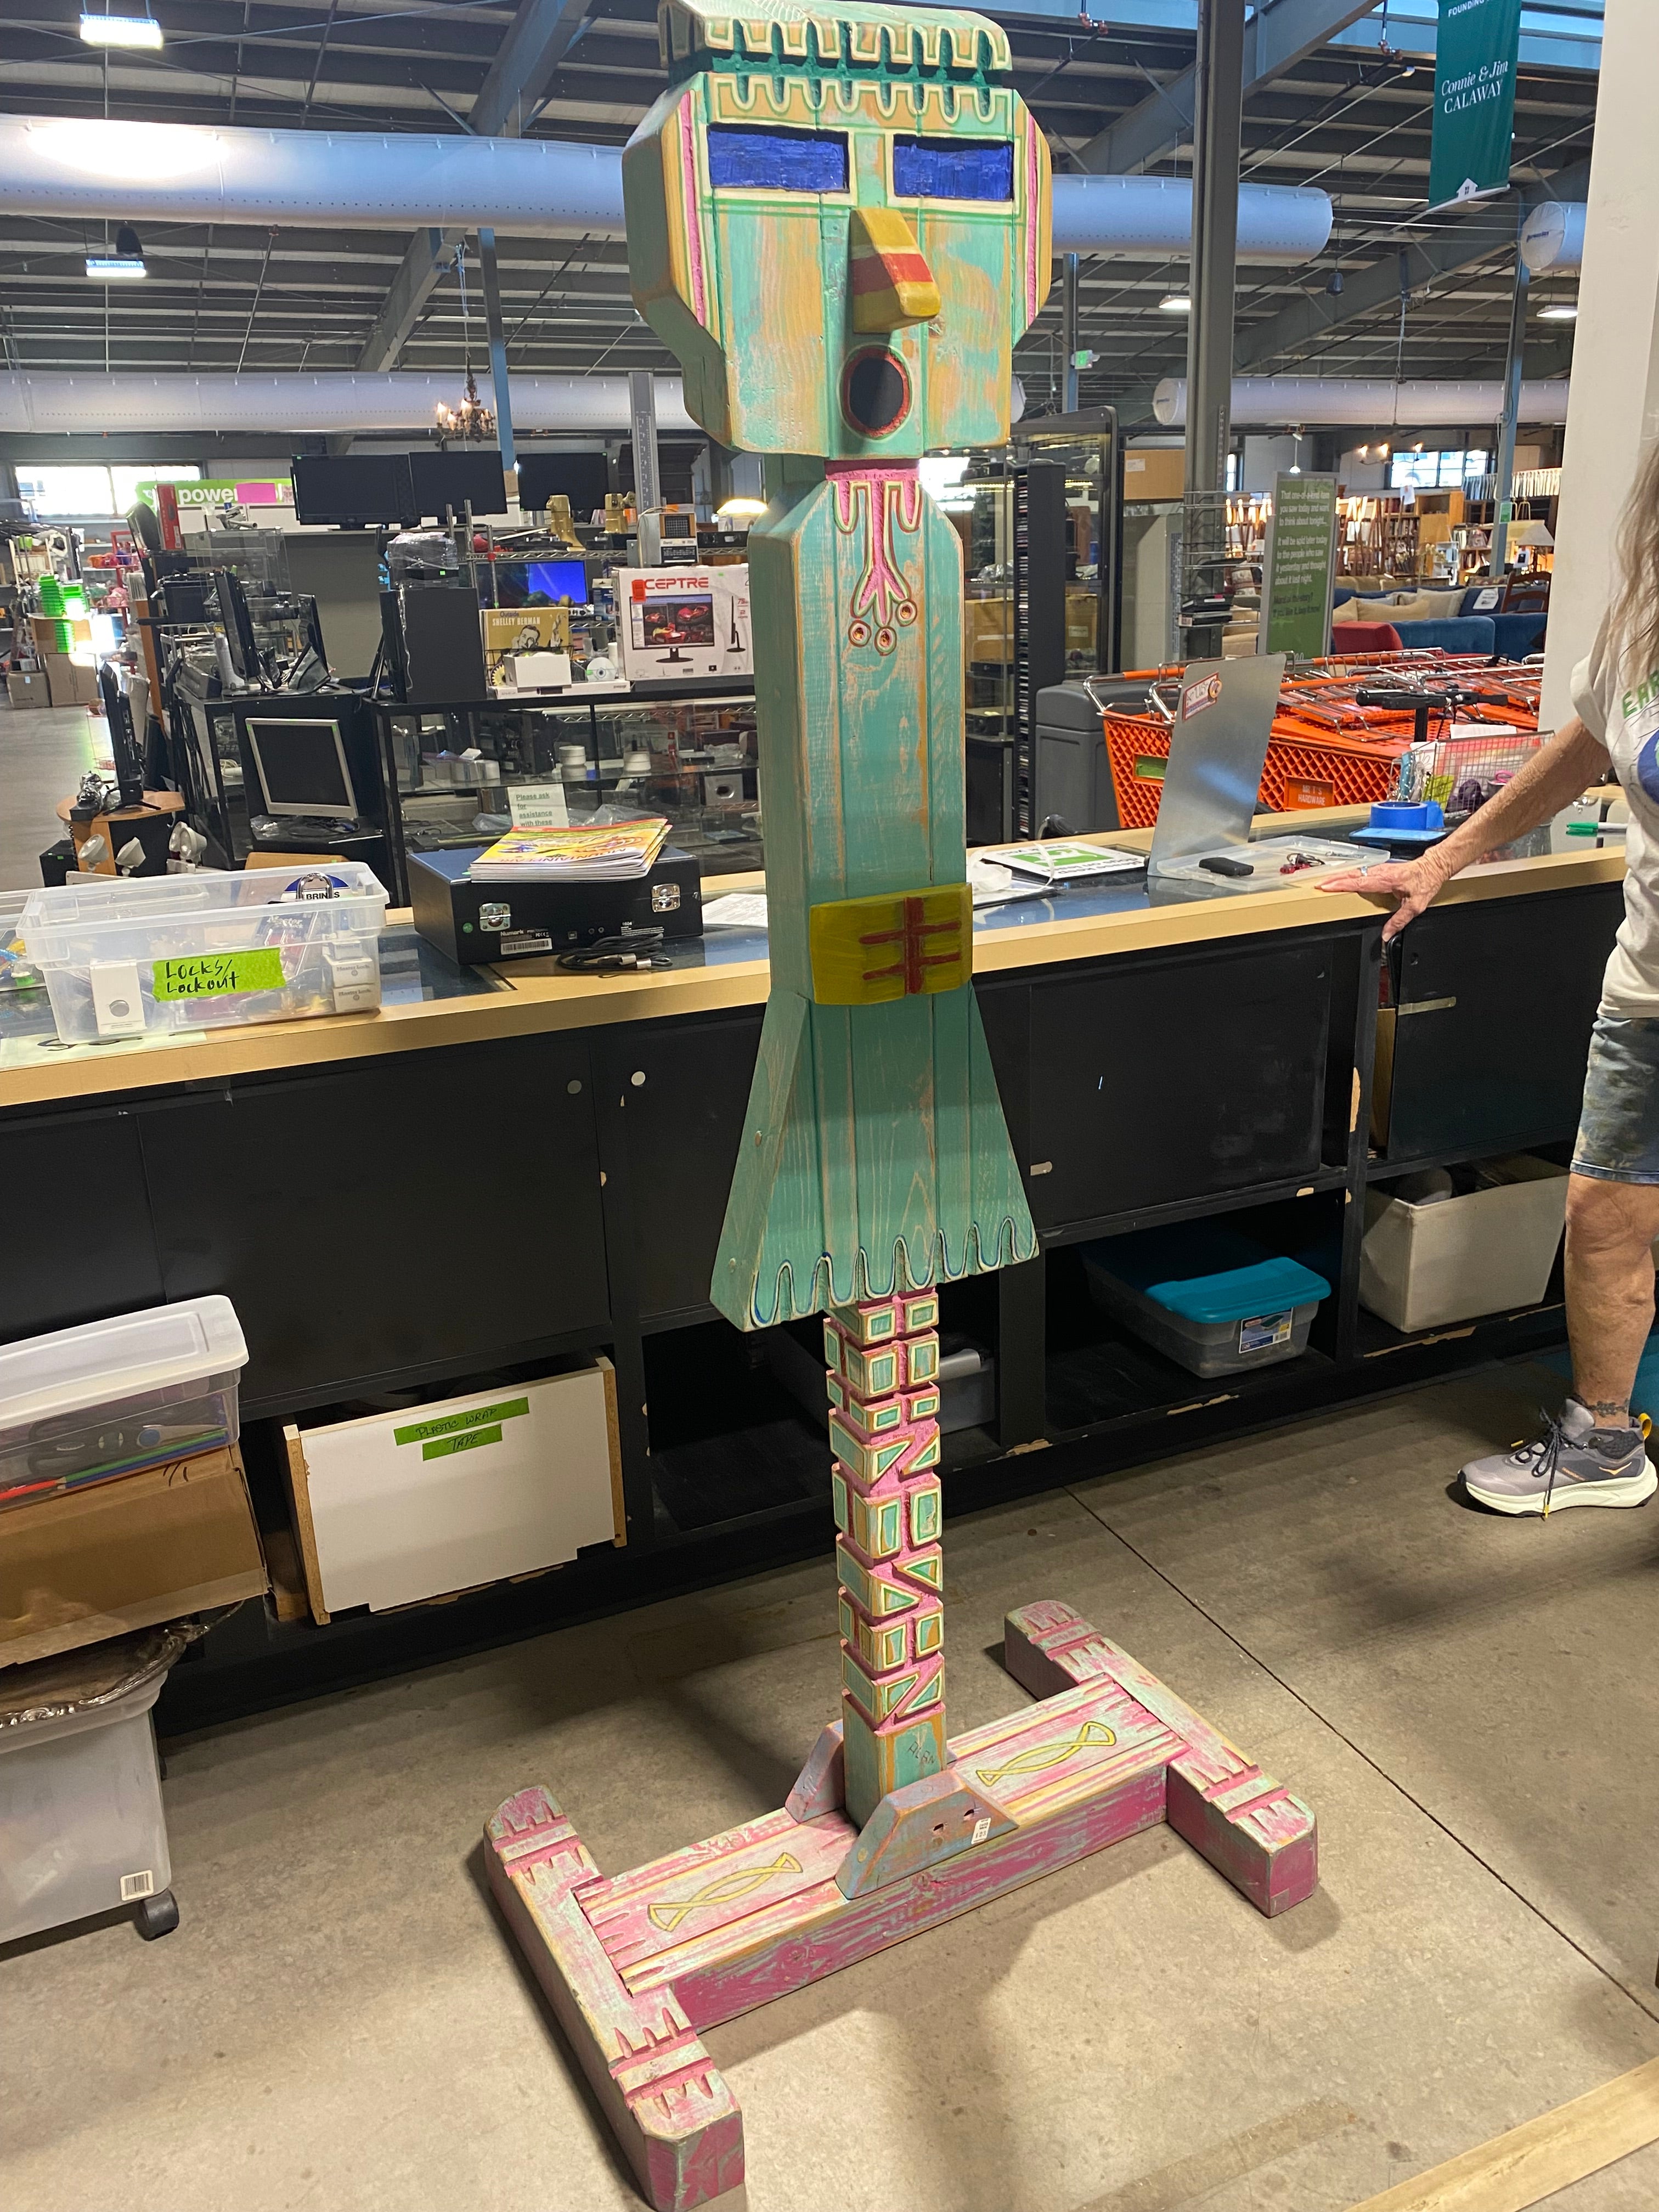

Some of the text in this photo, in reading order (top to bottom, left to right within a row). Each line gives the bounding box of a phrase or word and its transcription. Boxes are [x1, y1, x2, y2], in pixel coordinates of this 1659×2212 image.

[1442, 60, 1508, 96] Connie & Jim
[1444, 78, 1503, 114] CALAWAY
[644, 577, 709, 590] CEPTRE
[493, 617, 540, 626] SHELLEY BERMAN
[1298, 794, 1326, 806] HARDWARE
[306, 891, 340, 900] BRINS
[415, 1408, 498, 1438] PLASTIC WRAP
[447, 1432, 483, 1451] TAPE
